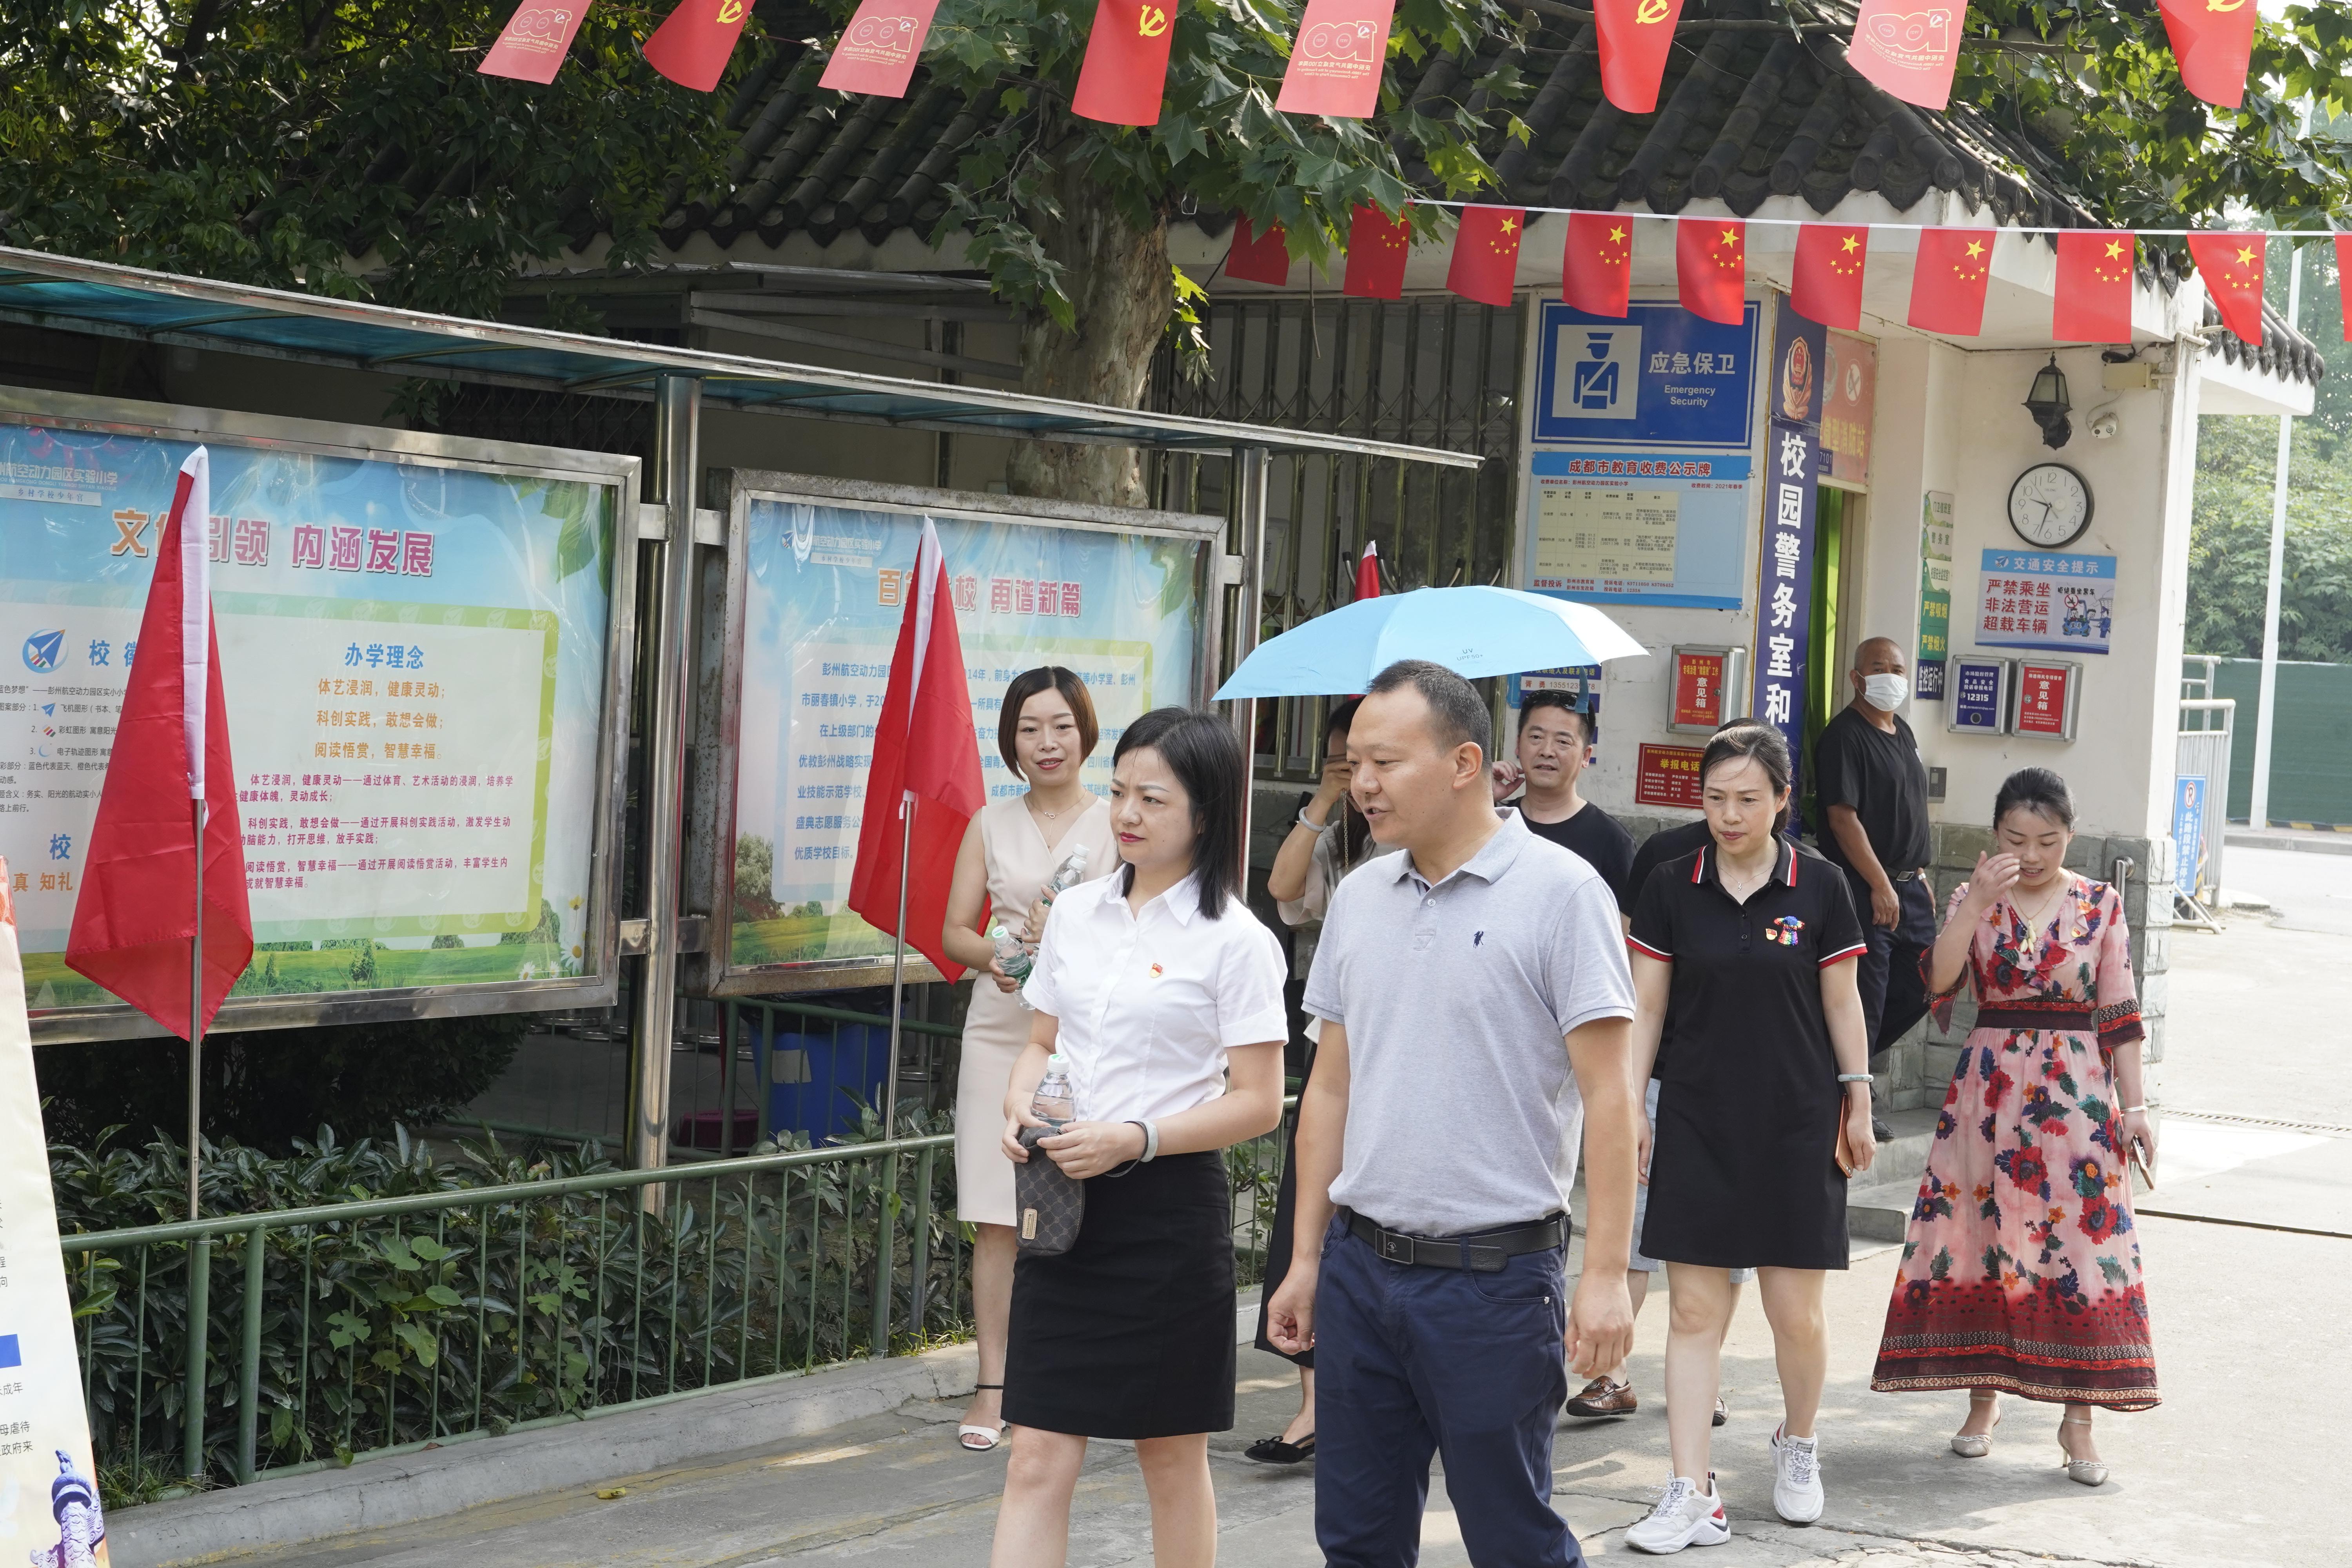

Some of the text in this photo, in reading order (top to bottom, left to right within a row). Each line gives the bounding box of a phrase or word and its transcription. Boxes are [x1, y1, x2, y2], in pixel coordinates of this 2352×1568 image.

[1648, 351, 1736, 375] 应急保卫
[1664, 385, 1716, 396] Emergency
[1670, 396, 1708, 408] Security
[1569, 459, 1711, 477] 成都市教育收费公示牌
[2048, 472, 2056, 483] 12
[2023, 486, 2033, 496] 10
[2071, 486, 2078, 497] 2
[2018, 499, 2026, 510] 9
[2075, 502, 2082, 512] 3
[2022, 514, 2029, 524] 8
[2069, 515, 2076, 526] 4
[2033, 524, 2040, 535] 7
[2044, 528, 2052, 539] 6
[2058, 525, 2066, 536] 5
[111, 508, 434, 577] 文引领 内涵发展
[2014, 557, 2098, 574] 交通安全提示
[1533, 579, 1562, 588] 监督投诉
[1765, 431, 1807, 726] 校园警务室和
[878, 568, 1082, 618] 百校 再谱新篇
[1986, 579, 2051, 597] 严禁乘坐
[1923, 601, 1948, 619] 严禁吸烟
[1985, 597, 2049, 615] 非法营运
[1983, 615, 2048, 634] 超载车辆
[1921, 635, 1945, 652] 严禁烟火
[345, 642, 425, 669] 办学理念
[966, 668, 1026, 682] 14年，前身为
[1918, 666, 1943, 693] 监控运行中
[33, 686, 127, 697] ——彭州航空动力园区实小小
[318, 678, 446, 699] 体艺浸润，健康灵动；
[1695, 677, 1708, 708] 意见箱
[2037, 681, 2050, 710] 意见箱
[1967, 693, 1989, 702] 12315
[316, 710, 444, 730] 科创实践，敢想会做；
[819, 724, 877, 738] 在上级部门的
[57, 748, 98, 756] 电子轨迹图形
[314, 741, 443, 760] 阅读悟赏，智慧幸福。
[799, 754, 872, 769] 优教彭州战略实现
[1660, 758, 1700, 772] 举报电话
[1082, 784, 1114, 796] 基础教
[795, 815, 862, 829] 盛典志愿服务公
[49, 833, 71, 860] 校
[794, 846, 853, 860] 优质学校目标。
[13, 872, 73, 892] 真 知礼
[0, 1439, 33, 1456] 政府来
